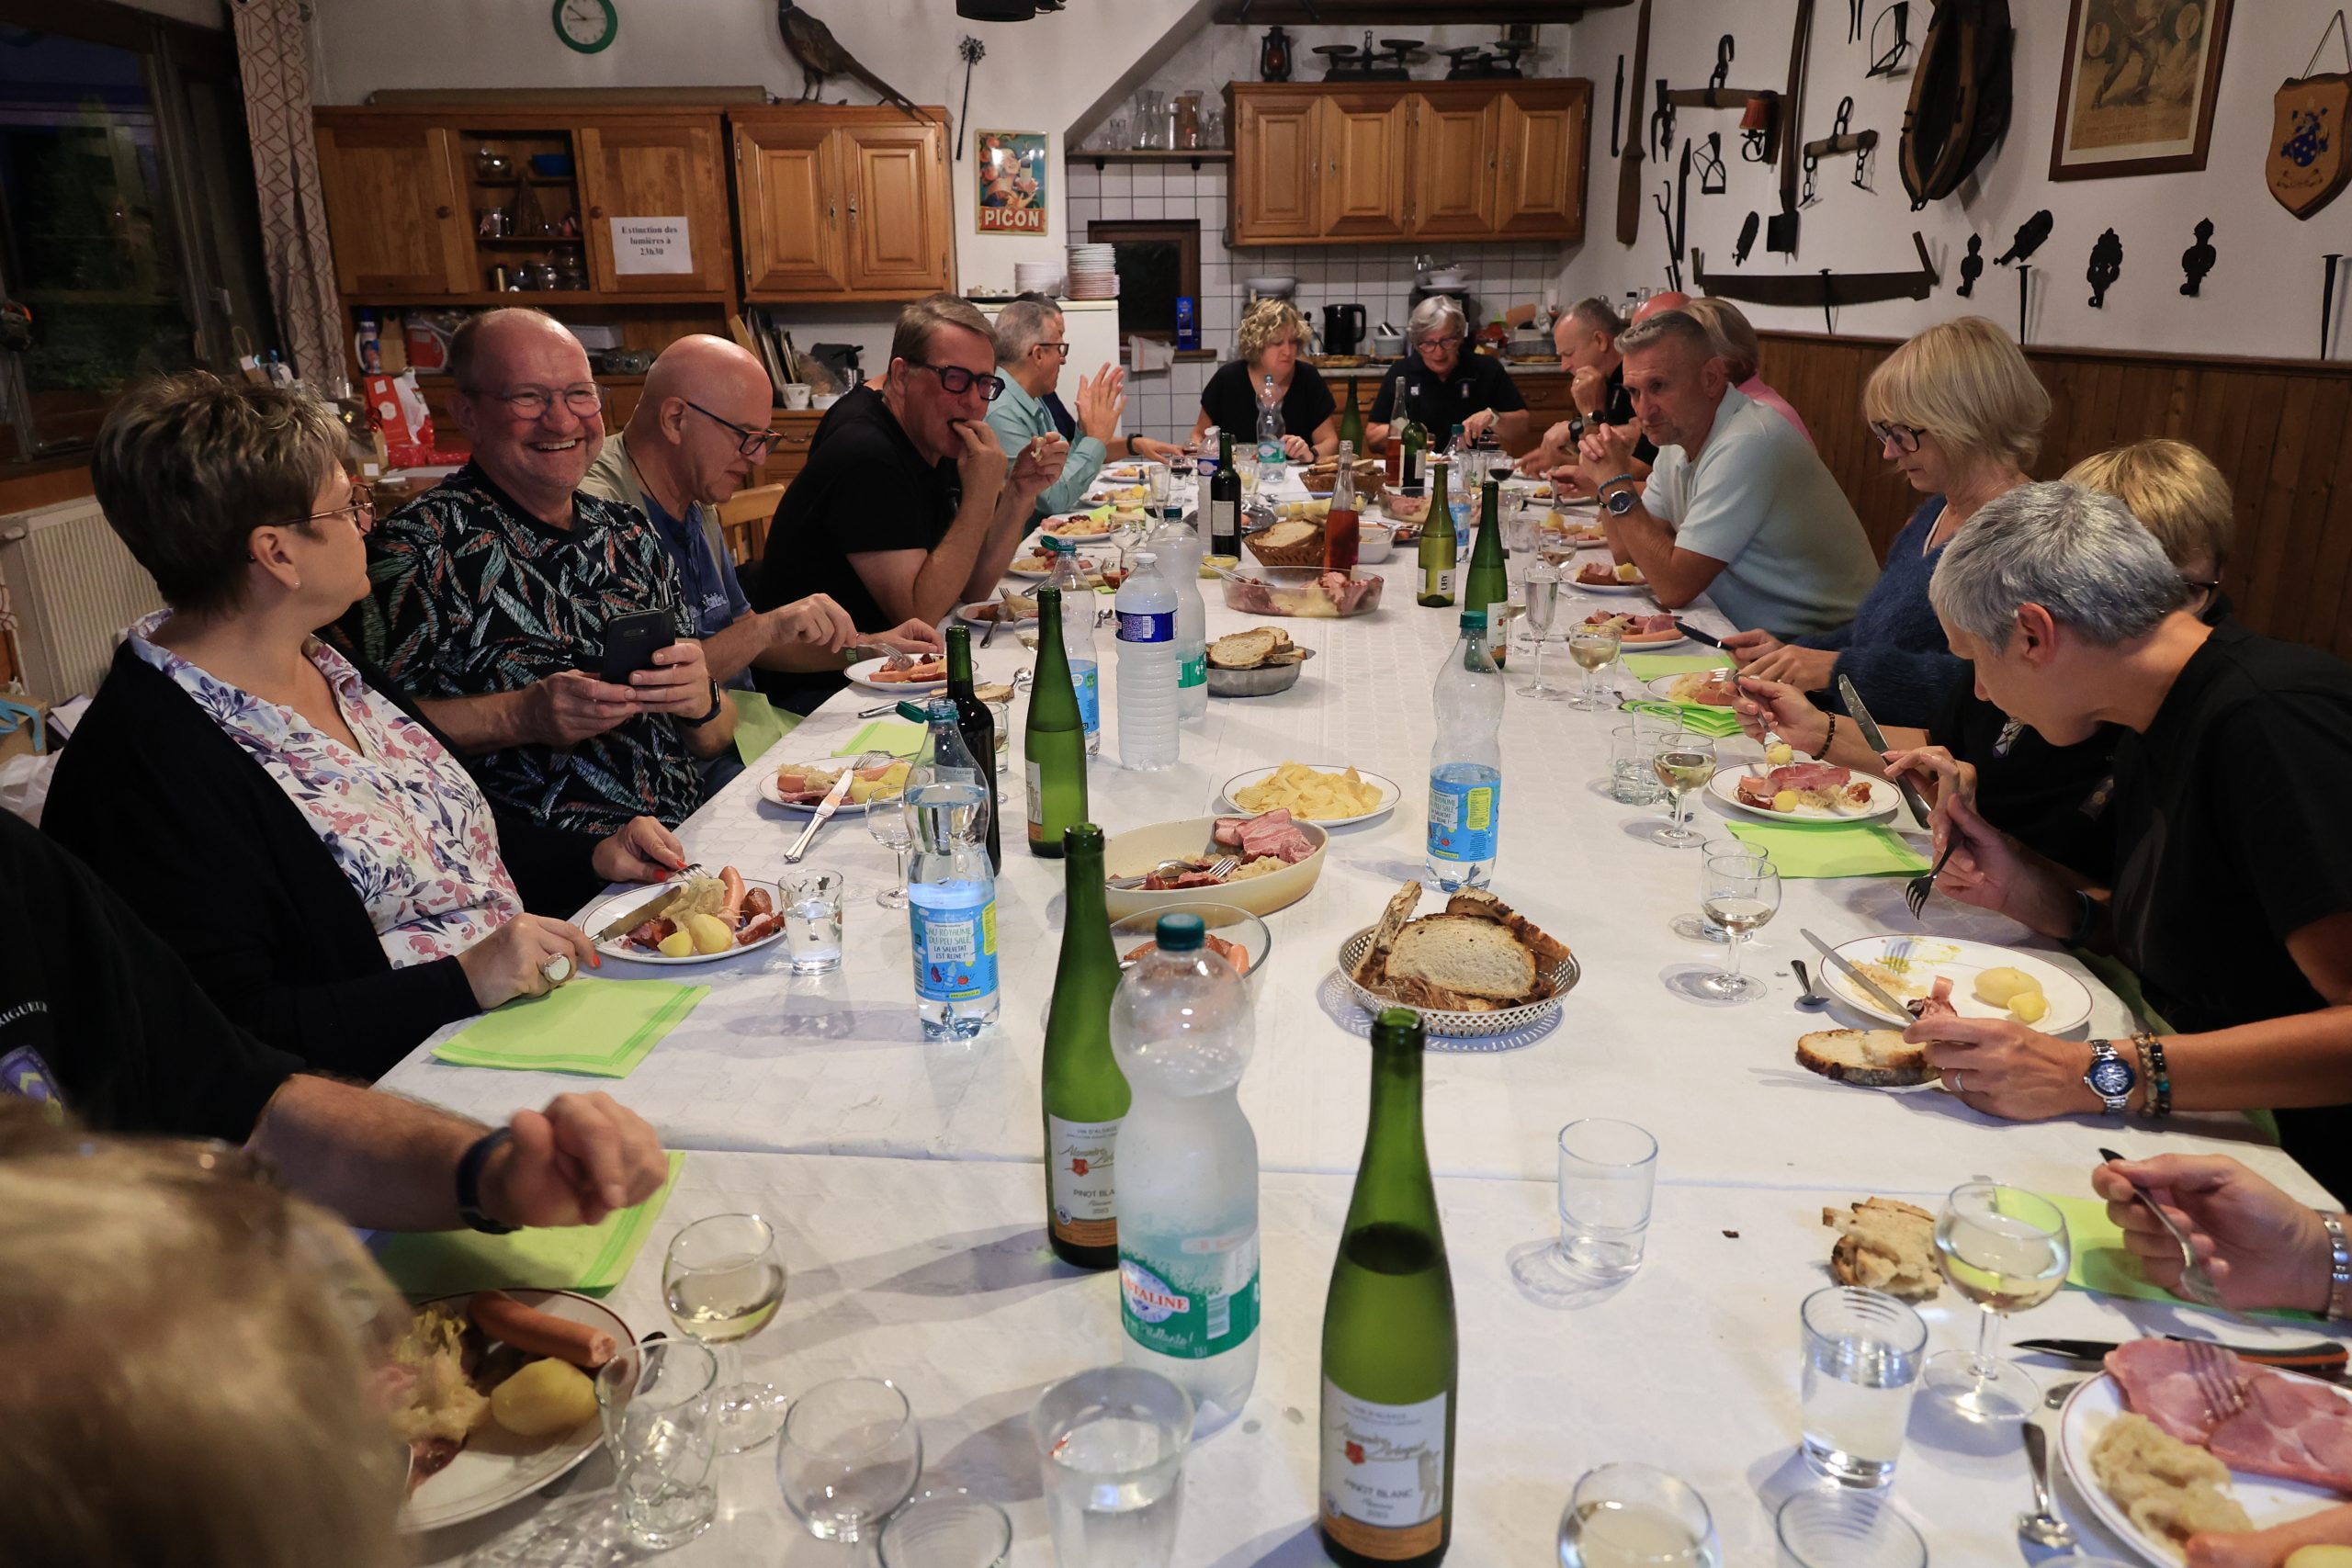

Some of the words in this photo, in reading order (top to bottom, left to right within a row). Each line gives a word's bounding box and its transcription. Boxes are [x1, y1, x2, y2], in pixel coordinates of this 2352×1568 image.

[984, 209, 1040, 227] PICON
[621, 226, 662, 234] Extinction
[664, 225, 678, 233] des
[639, 247, 663, 255] 23h30
[939, 927, 971, 937] ROYAUME
[929, 936, 938, 944] DU
[940, 937, 953, 945] PEU
[1073, 1189, 1096, 1199] PINOT
[1376, 1488, 1413, 1499] BLANC
